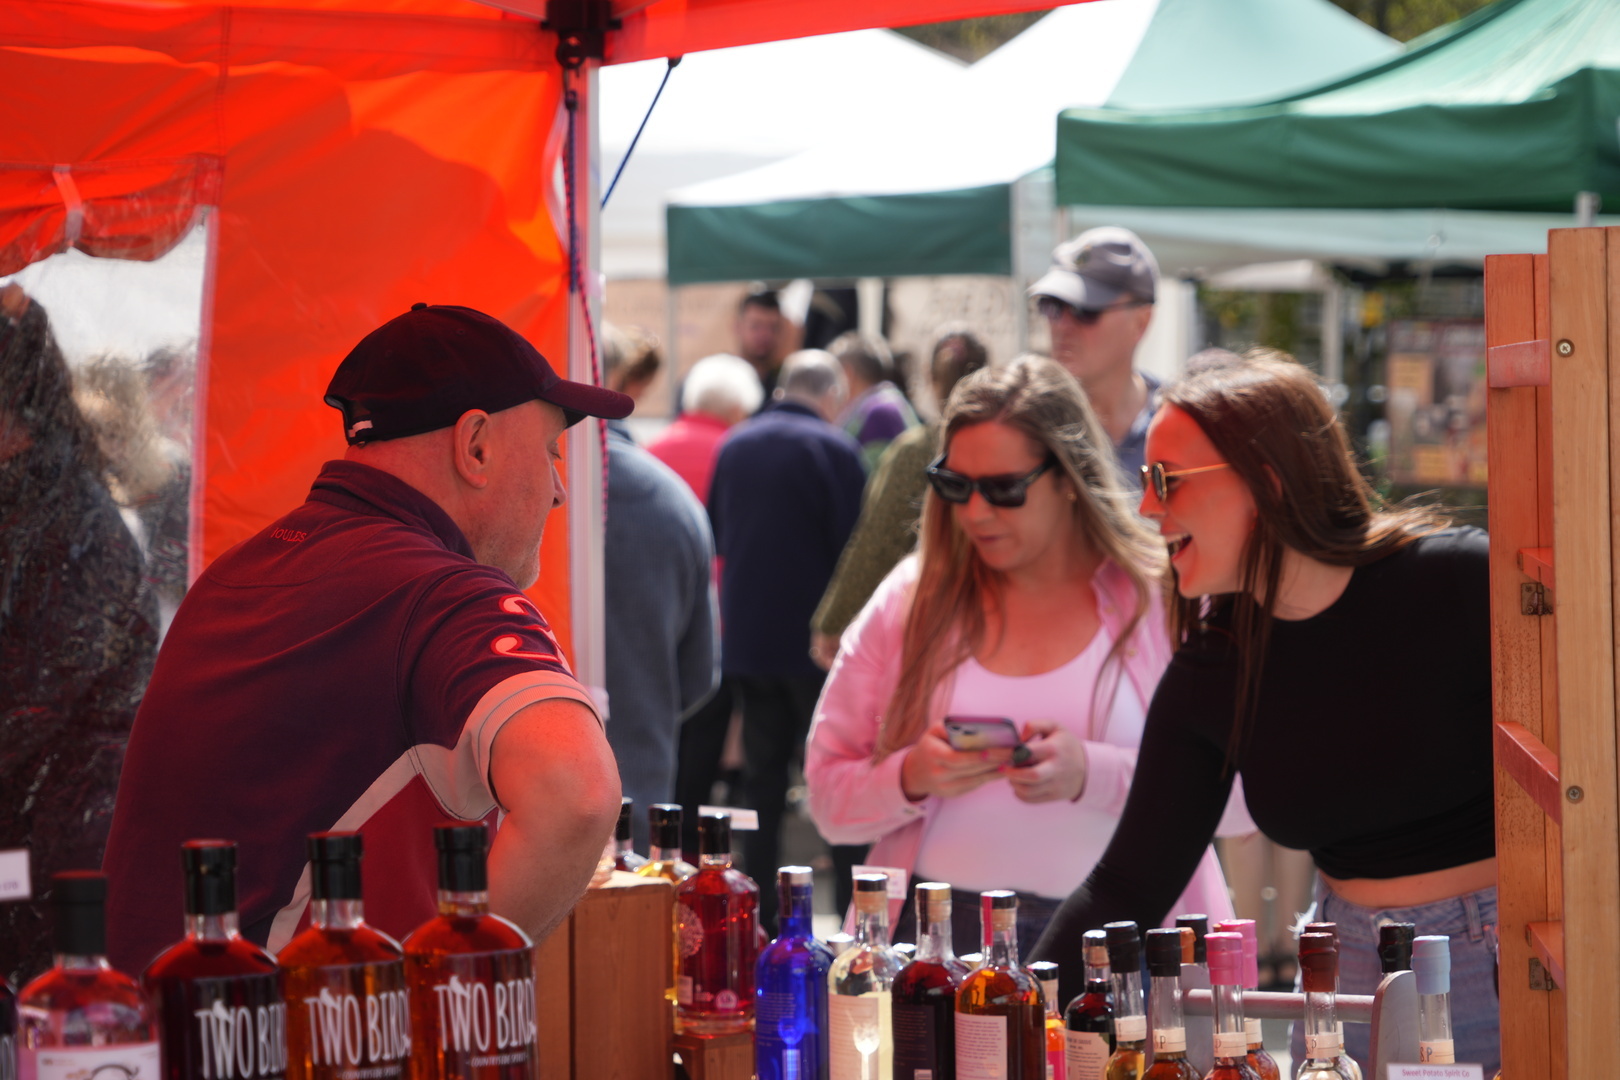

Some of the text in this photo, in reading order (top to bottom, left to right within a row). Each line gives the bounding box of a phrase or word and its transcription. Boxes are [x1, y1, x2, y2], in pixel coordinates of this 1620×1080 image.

[270, 527, 307, 542] JOULES
[194, 1000, 254, 1079] TWO
[303, 987, 362, 1066] TWO
[433, 976, 491, 1052] TWO
[1402, 1069, 1470, 1078] Sweet Potato Spirit Co
